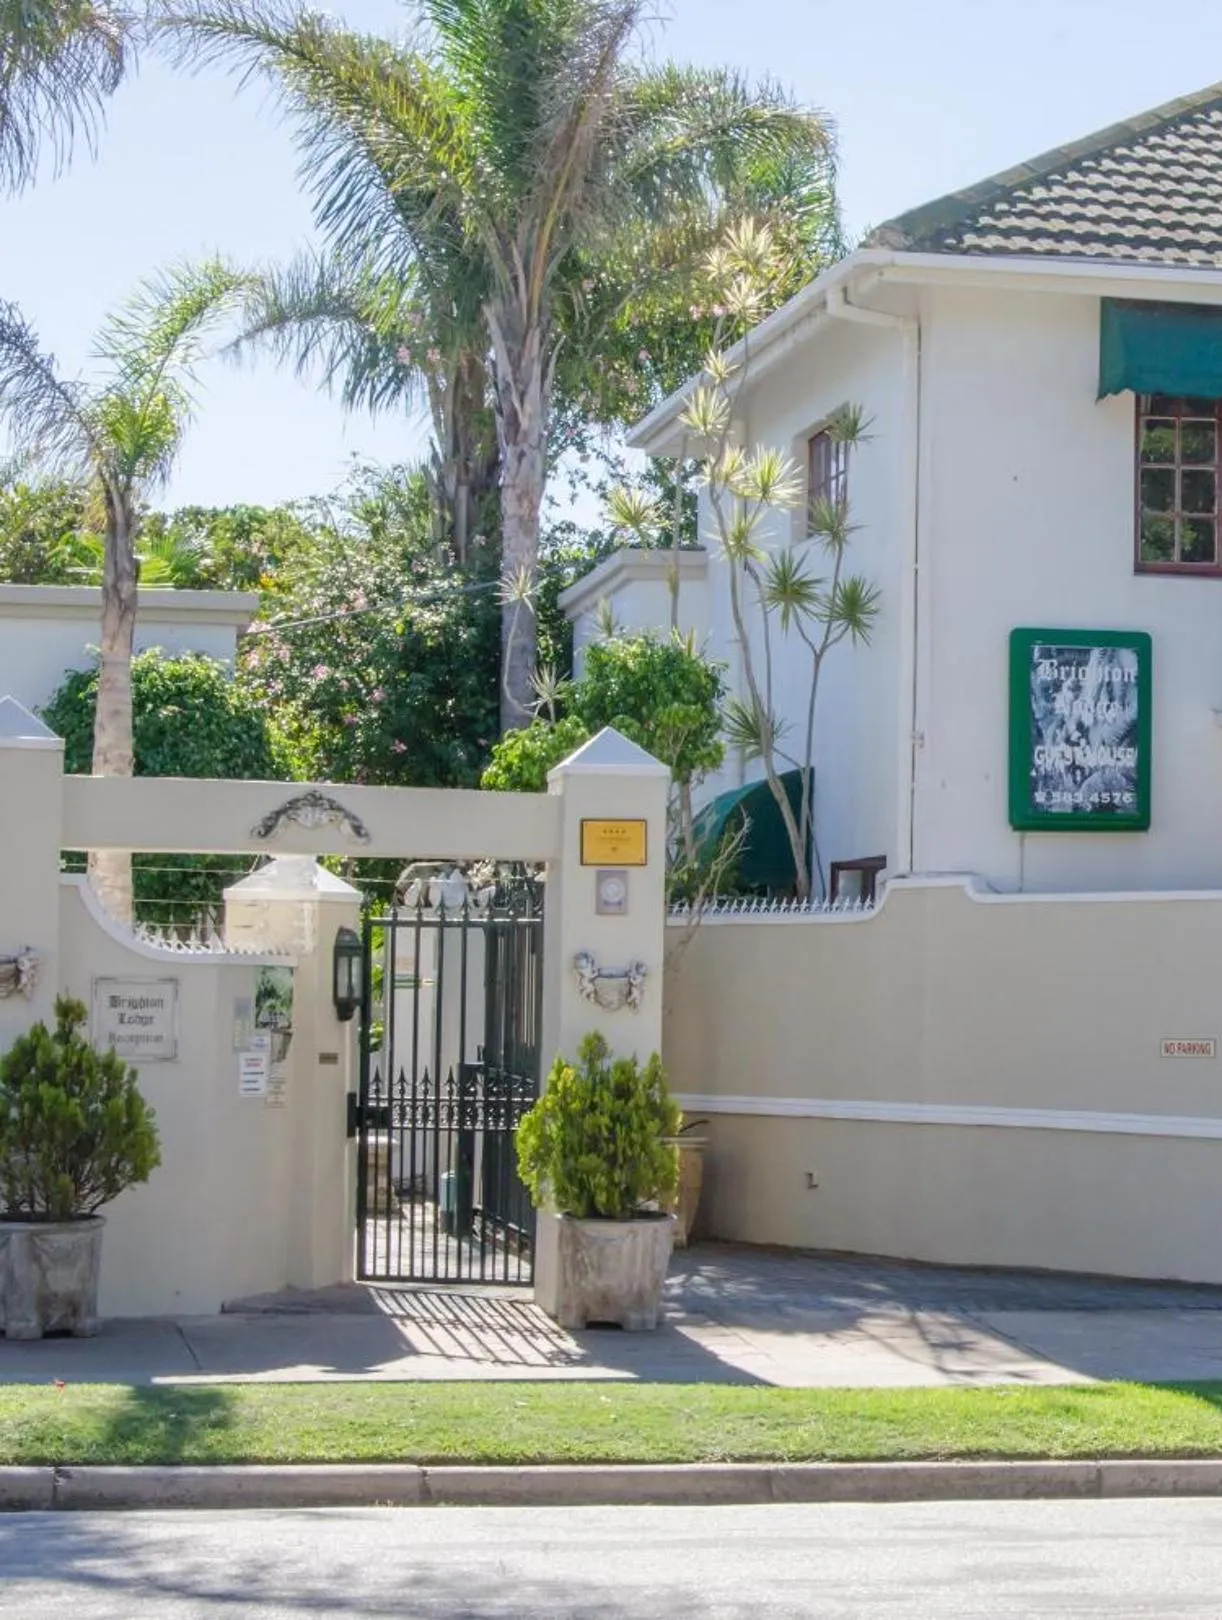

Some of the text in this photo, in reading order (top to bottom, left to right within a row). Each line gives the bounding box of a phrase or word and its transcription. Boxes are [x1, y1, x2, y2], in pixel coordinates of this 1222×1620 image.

[1089, 791, 1134, 804] 4576
[1165, 1042, 1211, 1054] NO PARKING
